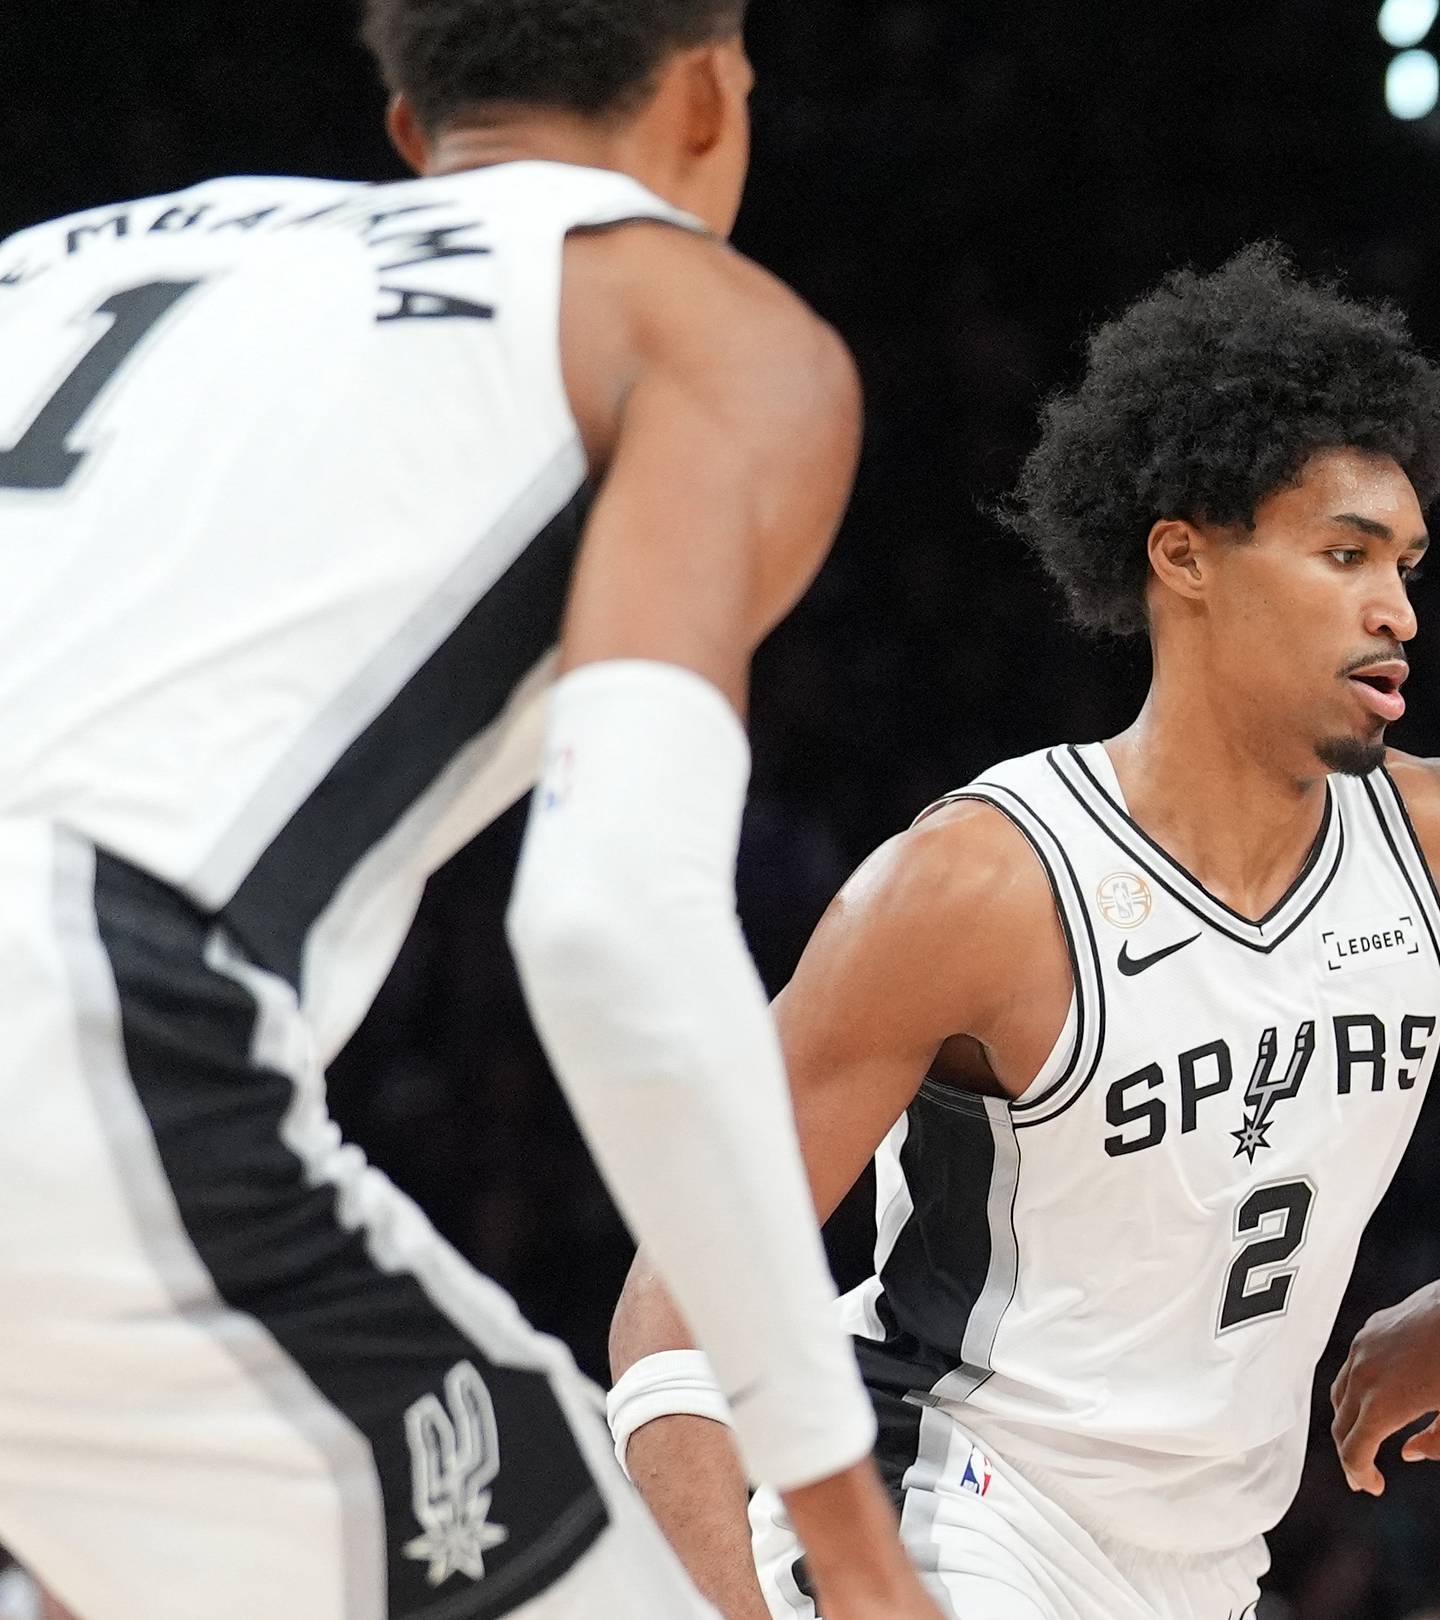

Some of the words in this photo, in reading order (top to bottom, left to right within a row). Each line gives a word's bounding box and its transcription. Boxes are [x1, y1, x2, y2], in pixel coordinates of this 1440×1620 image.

[0, 279, 212, 489] 1
[1336, 929, 1405, 957] LEDGER
[1103, 1014, 1436, 1164] SPURS
[1215, 1174, 1319, 1339] 2
